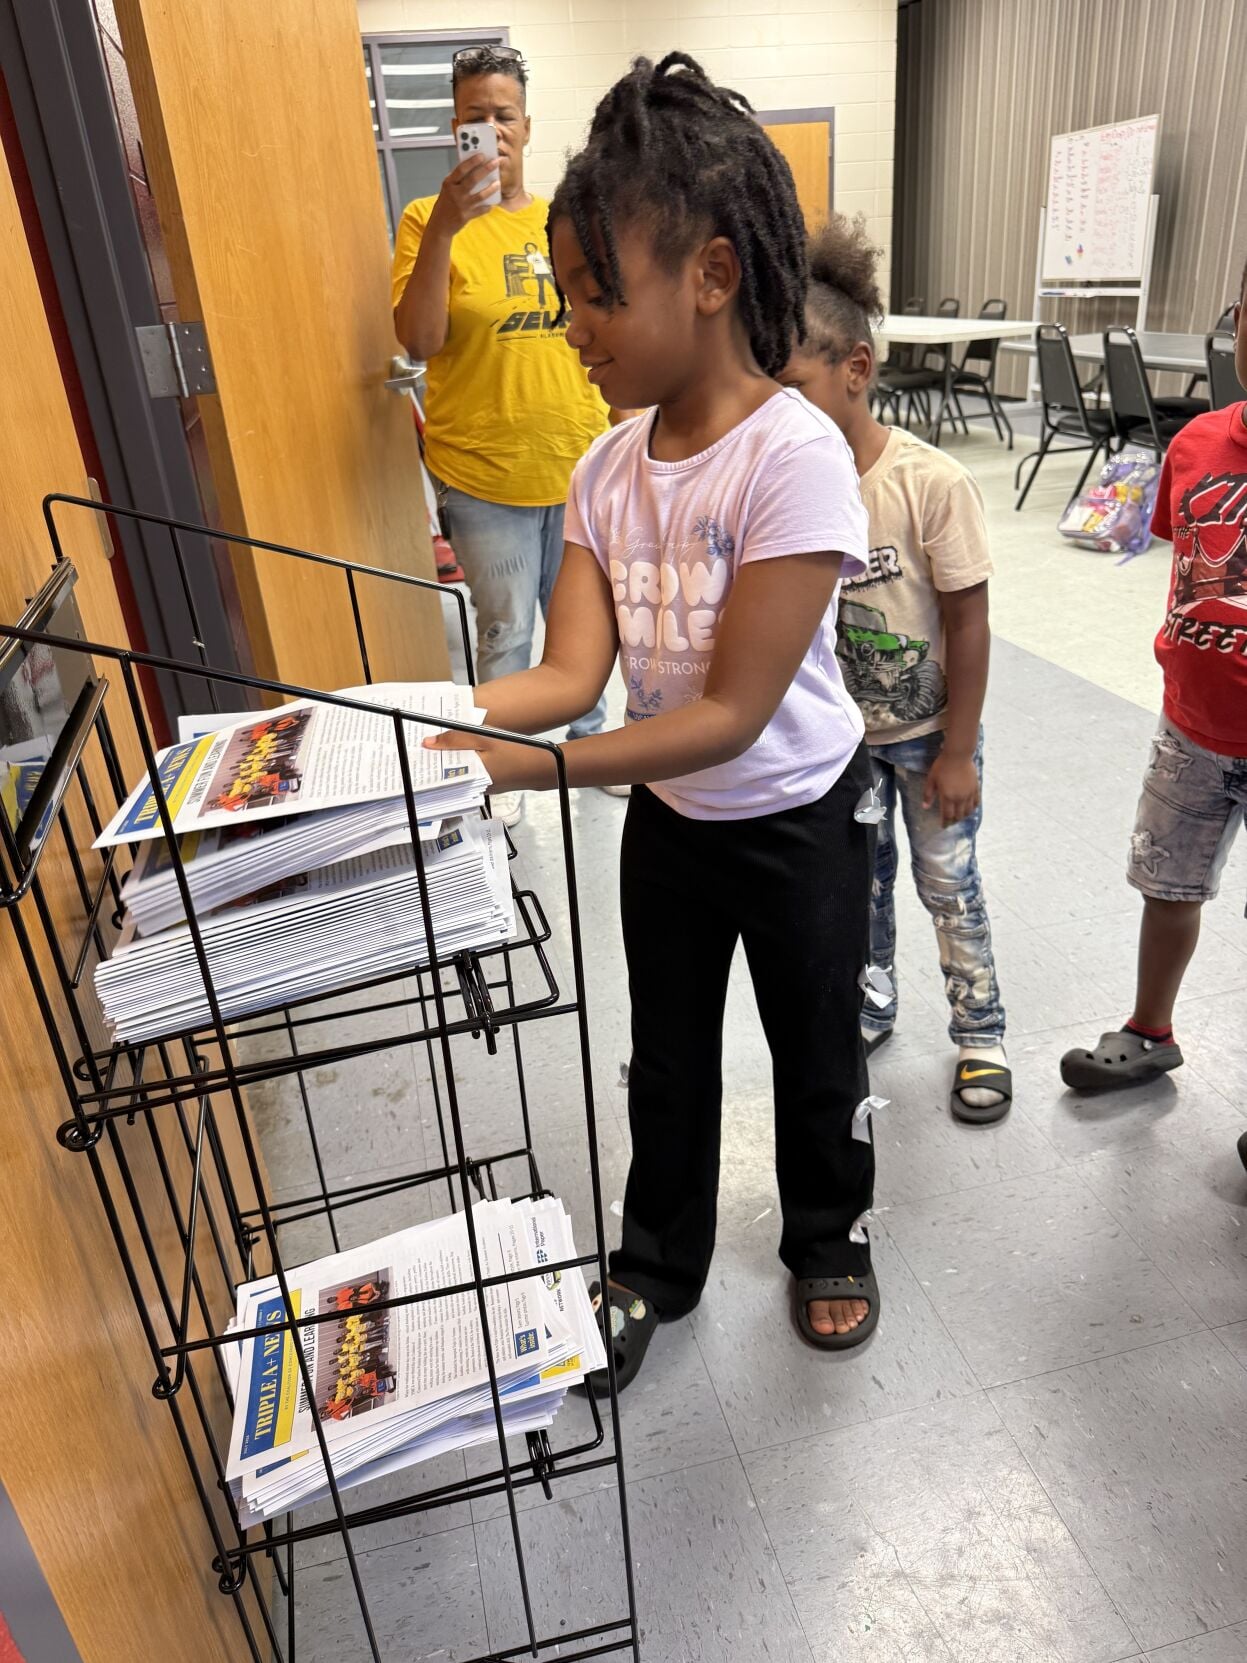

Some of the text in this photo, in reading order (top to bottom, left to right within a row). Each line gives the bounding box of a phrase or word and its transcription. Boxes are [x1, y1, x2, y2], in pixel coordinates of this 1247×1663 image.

[254, 1309, 282, 1441] TRIPLE A+ NES
[303, 1345, 315, 1362] AND
